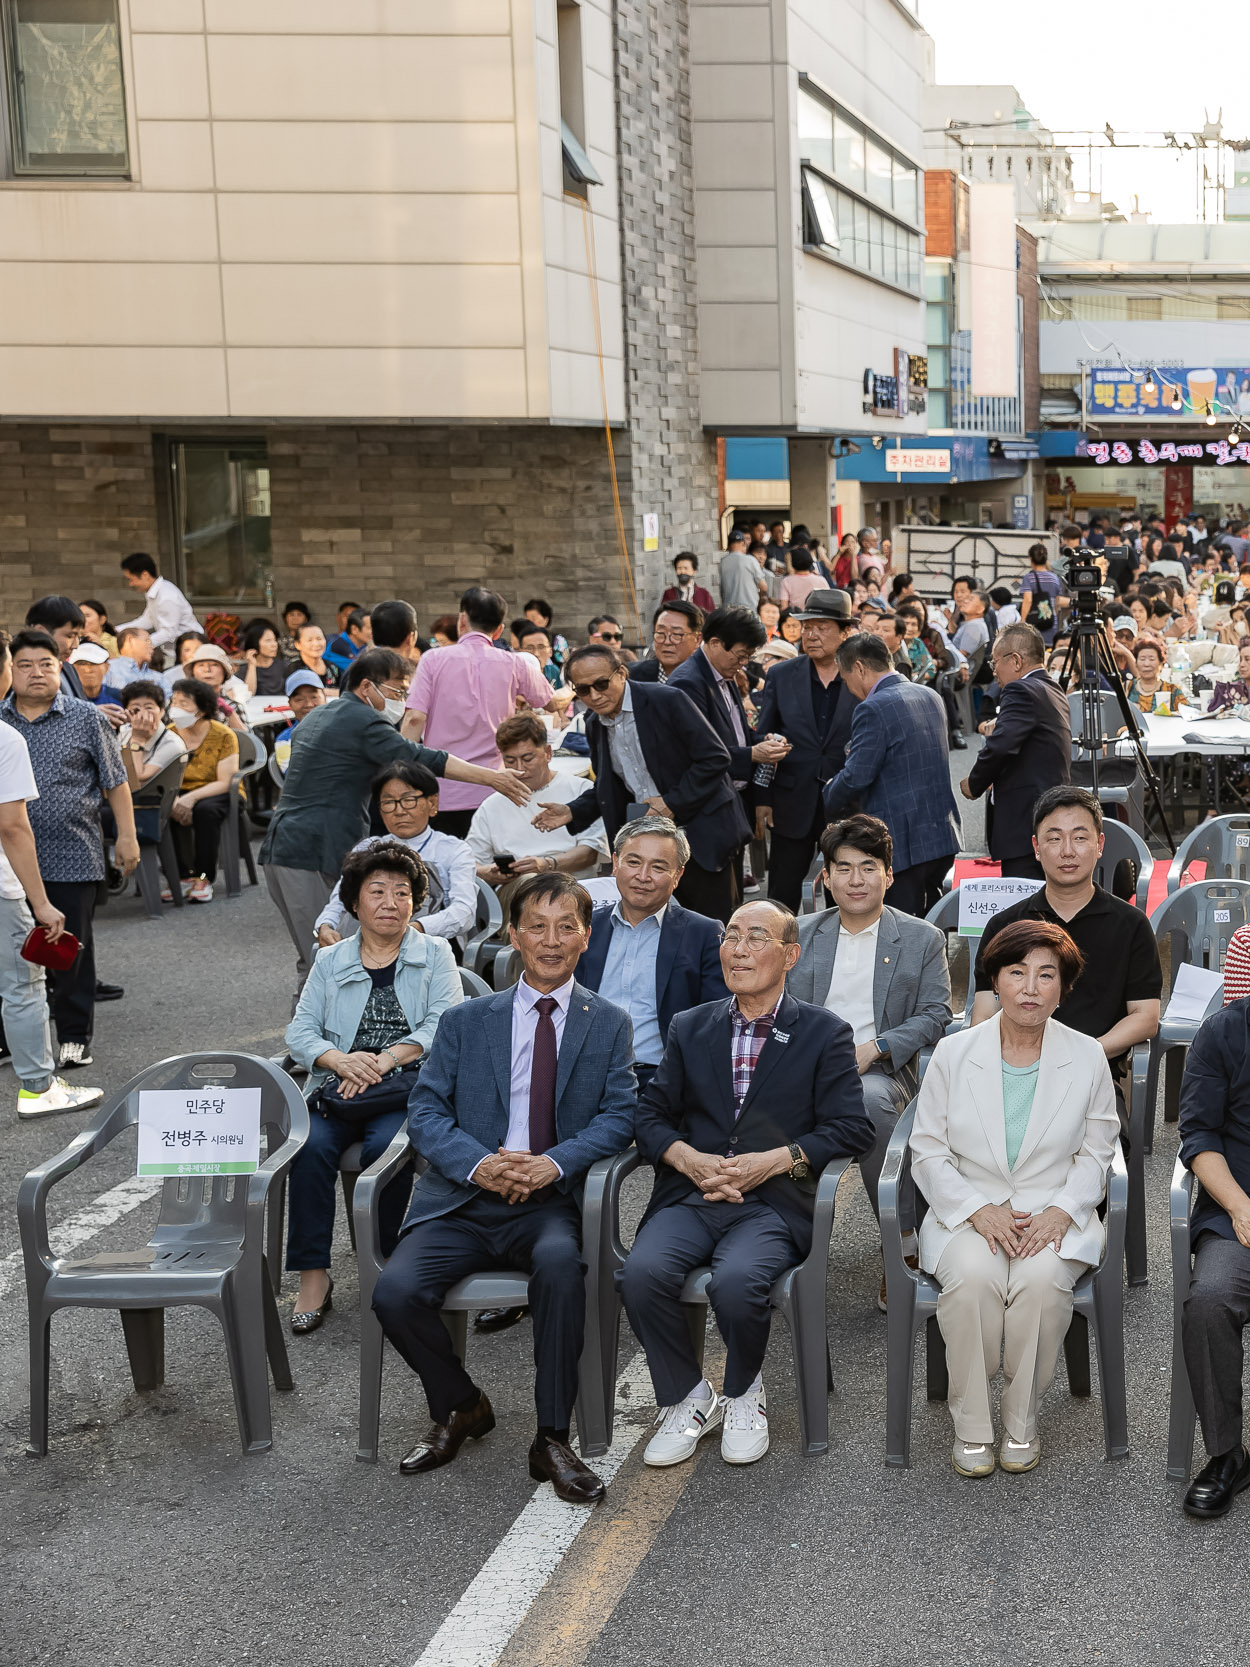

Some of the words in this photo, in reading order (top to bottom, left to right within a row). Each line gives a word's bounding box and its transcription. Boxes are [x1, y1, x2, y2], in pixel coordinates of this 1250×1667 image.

[1087, 442, 1132, 463] 명동
[890, 455, 949, 467] 주차관리실
[964, 884, 979, 892] 세계
[980, 884, 1015, 893] 프리스타일
[1016, 885, 1041, 893] 축구연
[968, 902, 999, 915] 신선우
[1215, 912, 1229, 921] 205
[186, 1099, 225, 1114] 민주당
[161, 1130, 208, 1147] 전병주
[211, 1135, 244, 1145] 시의원님
[177, 1165, 220, 1173] 중곡제일시장
